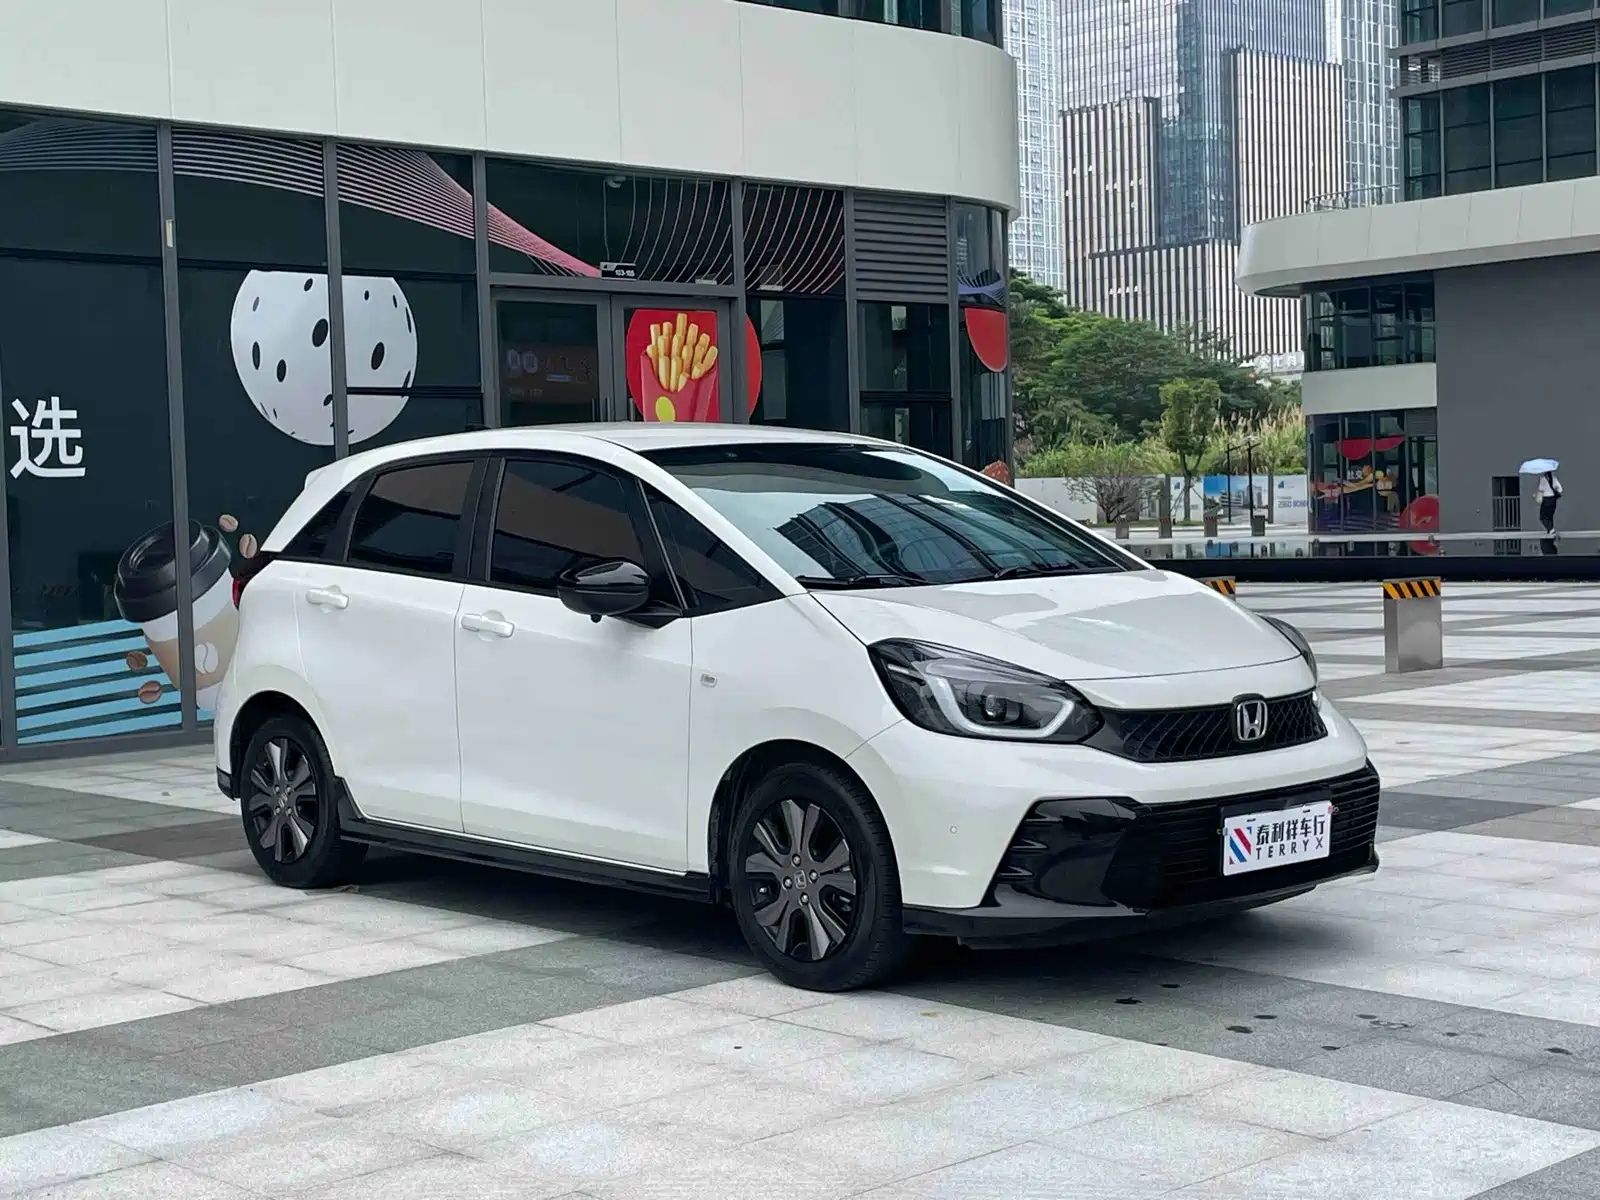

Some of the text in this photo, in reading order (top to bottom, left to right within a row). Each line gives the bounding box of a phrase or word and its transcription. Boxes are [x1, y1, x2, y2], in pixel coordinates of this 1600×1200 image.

[10, 396, 86, 479] 选
[1256, 814, 1326, 846] 泰利祥车行
